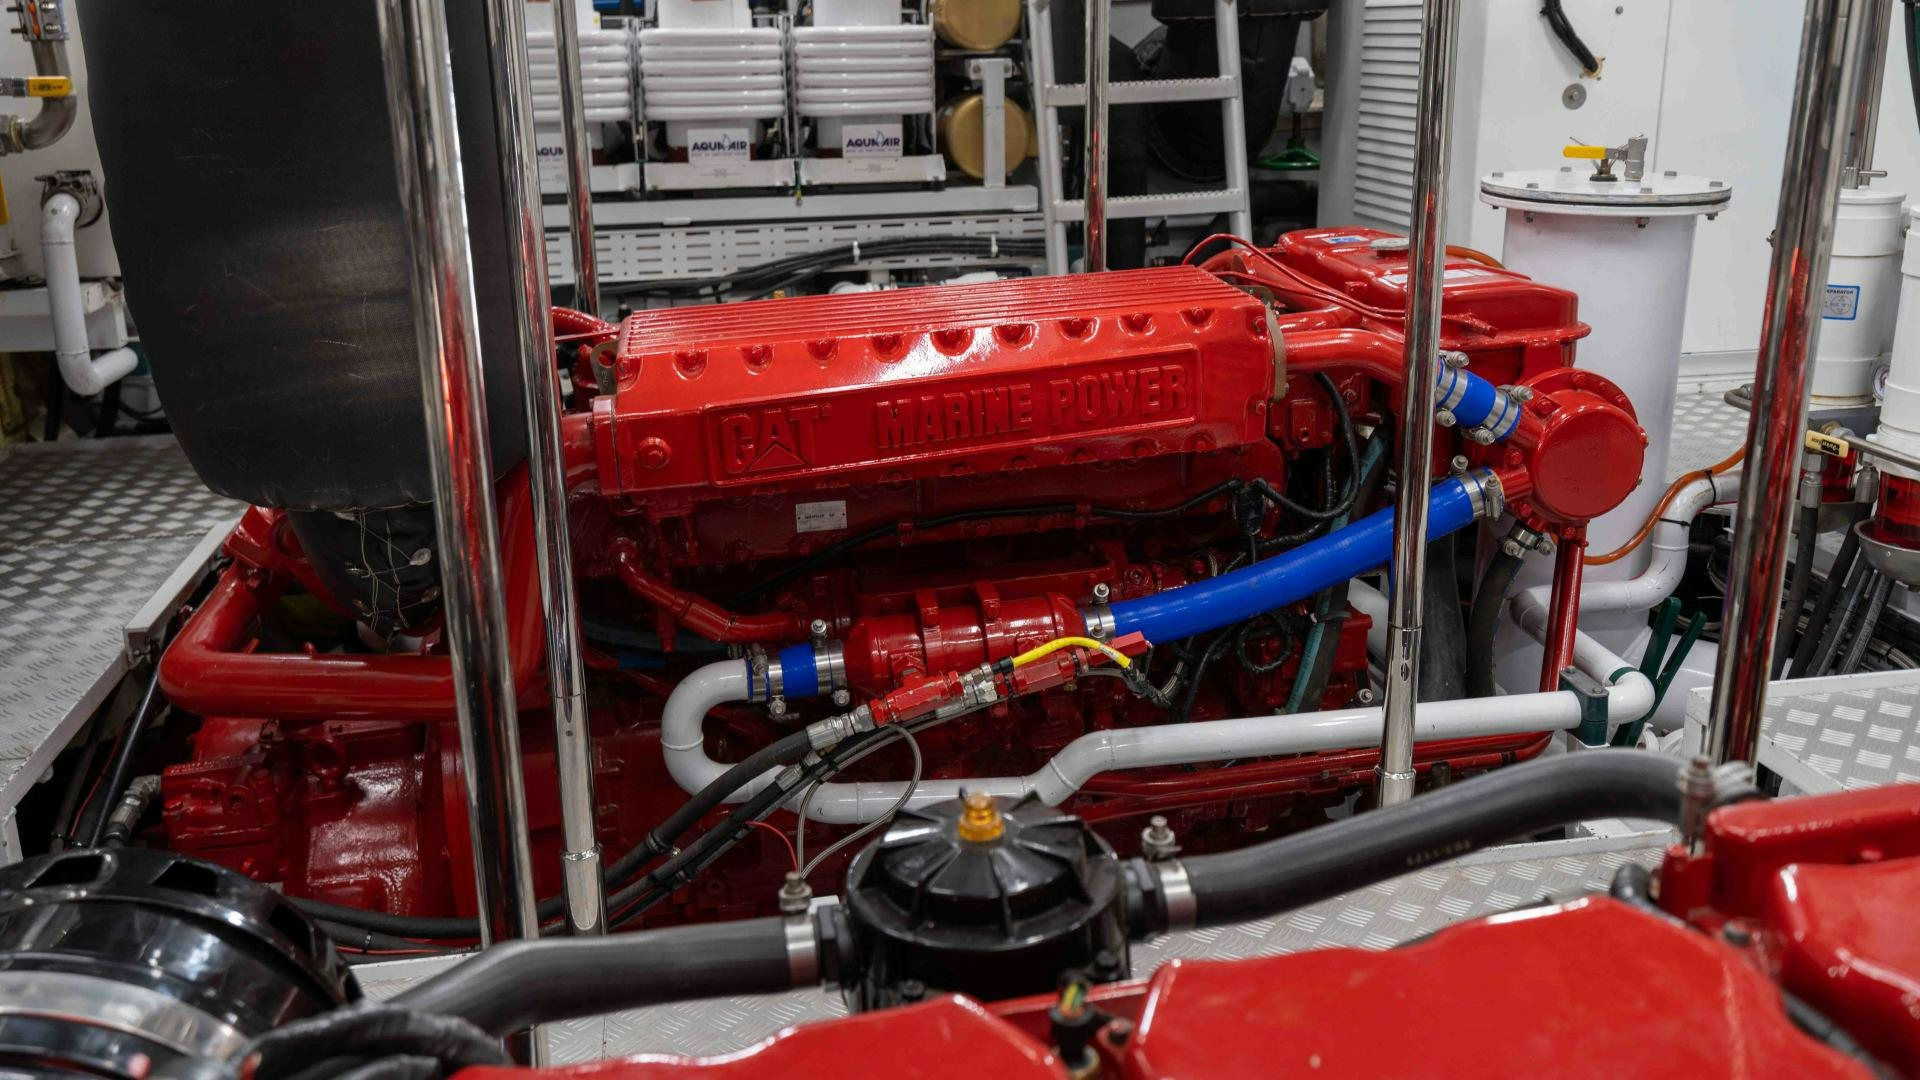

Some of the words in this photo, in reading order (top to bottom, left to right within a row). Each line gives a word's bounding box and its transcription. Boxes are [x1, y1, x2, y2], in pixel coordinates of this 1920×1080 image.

[691, 141, 725, 151] AQUA
[728, 140, 748, 151] AIR
[846, 138, 879, 148] AQUA
[881, 137, 901, 147] AIR
[721, 404, 818, 475] CAT
[876, 383, 1032, 449] MARINE
[1050, 364, 1187, 427] POWER
